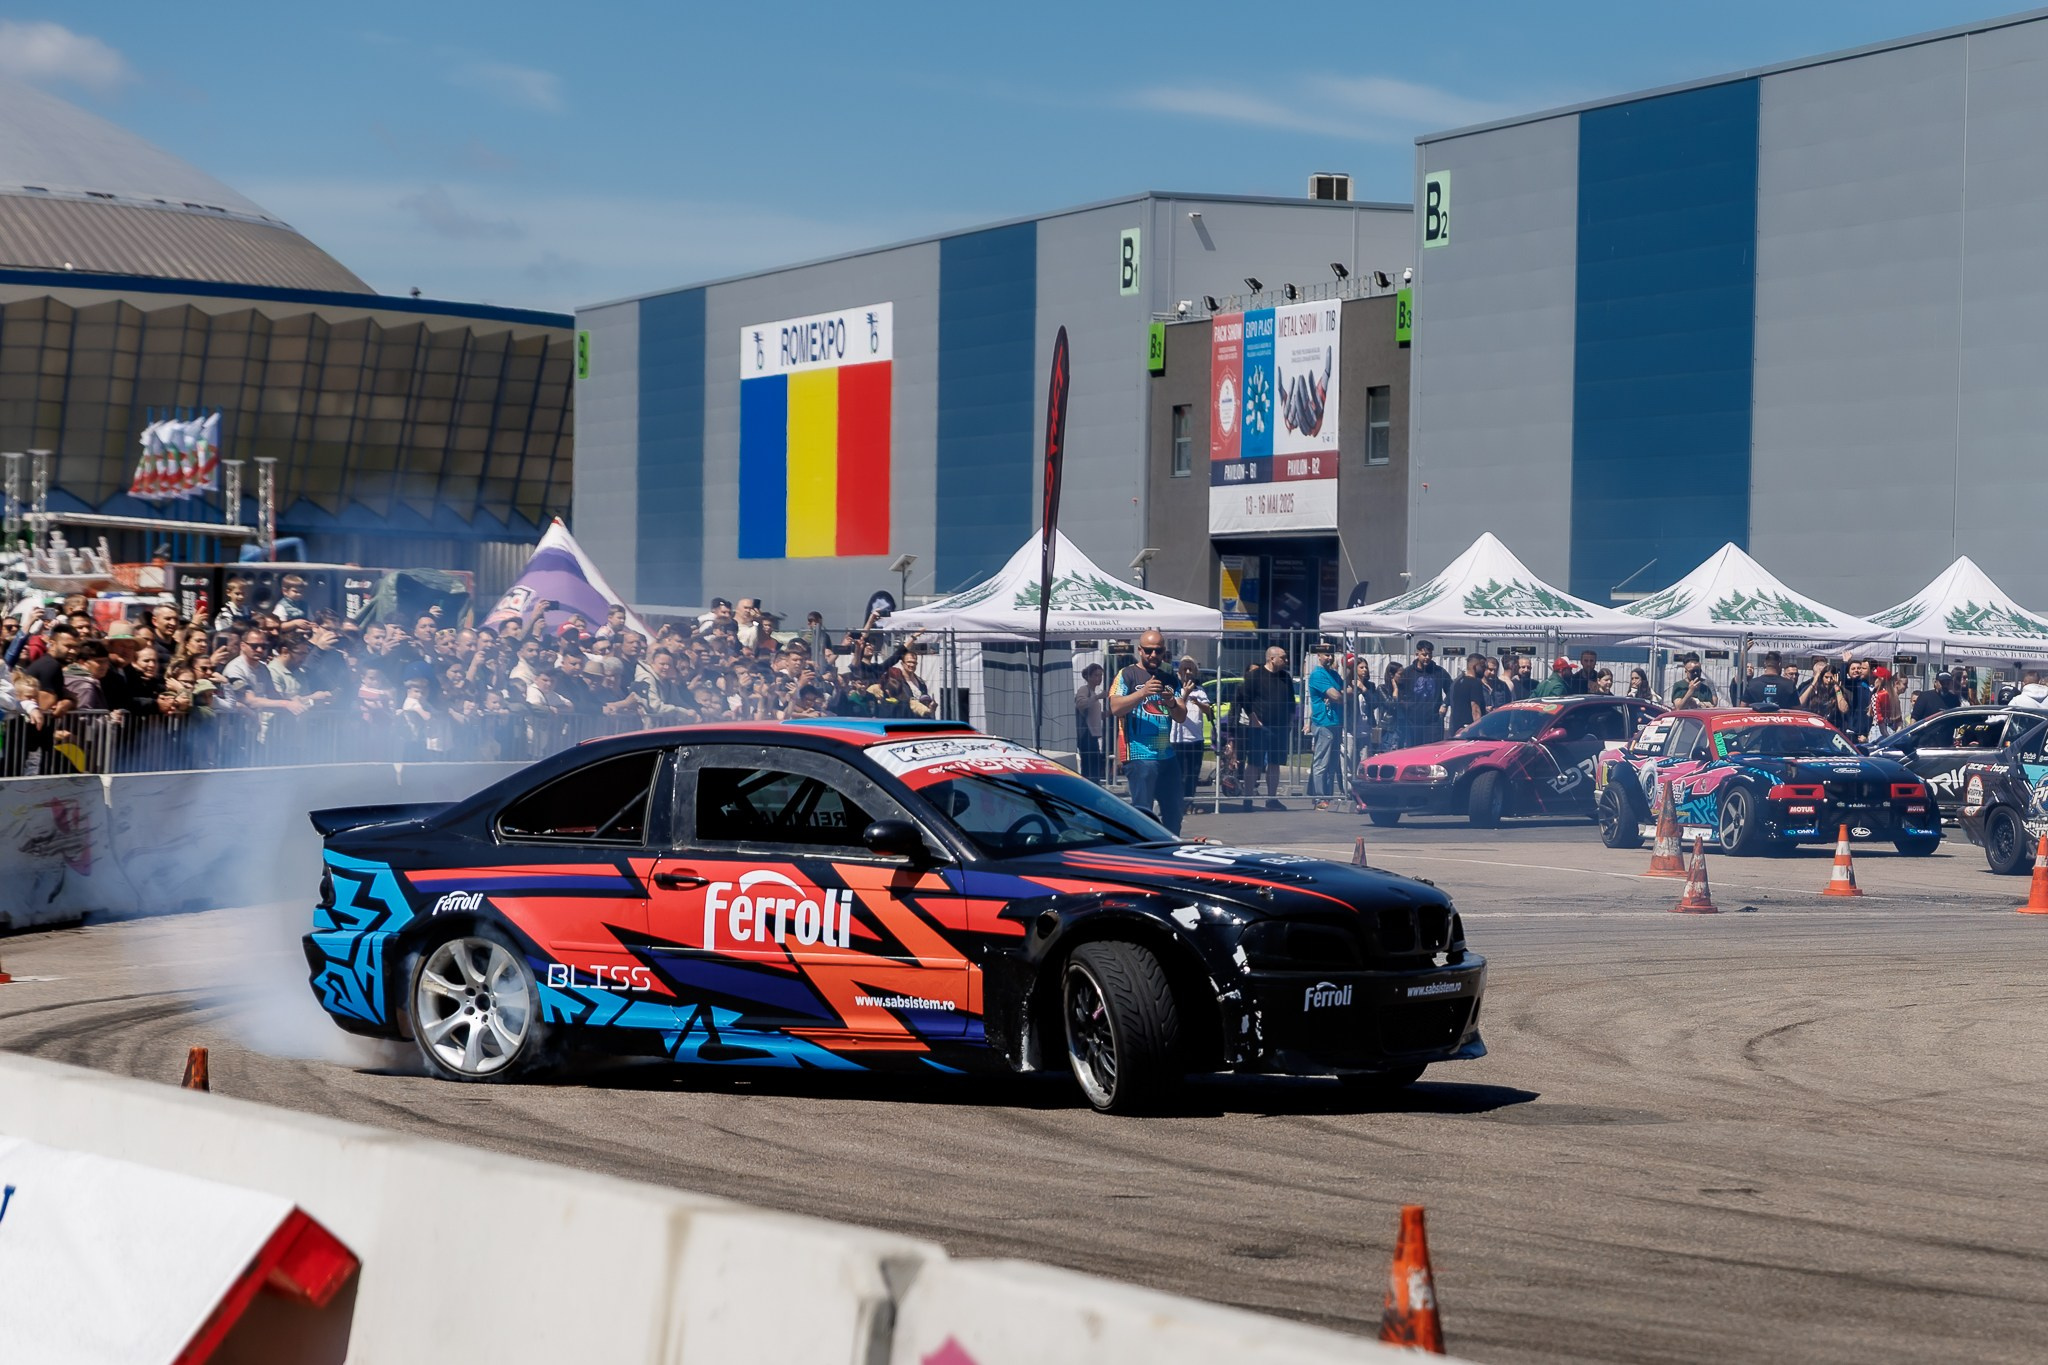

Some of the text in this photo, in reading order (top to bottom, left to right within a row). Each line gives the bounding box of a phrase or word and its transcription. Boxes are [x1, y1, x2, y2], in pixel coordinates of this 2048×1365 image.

[1214, 323, 1242, 343] PACK SHOW
[1258, 318, 1274, 336] PLAST
[1278, 315, 1298, 338] METAL
[1299, 312, 1318, 335] SHOW
[1326, 310, 1336, 332] TIB
[780, 318, 846, 367] ROMEXPO
[1267, 494, 1279, 514] MAI
[1280, 493, 1294, 513] 2025
[1463, 609, 1594, 618] CARAIMAN
[432, 892, 484, 915] Ferroli
[703, 880, 854, 950] Ferroli
[547, 963, 651, 991] BLISS
[1303, 984, 1352, 1011] Ferroli
[1407, 982, 1462, 997] www.sabsistem.ro
[854, 995, 956, 1011] www.sabsistem.ro
